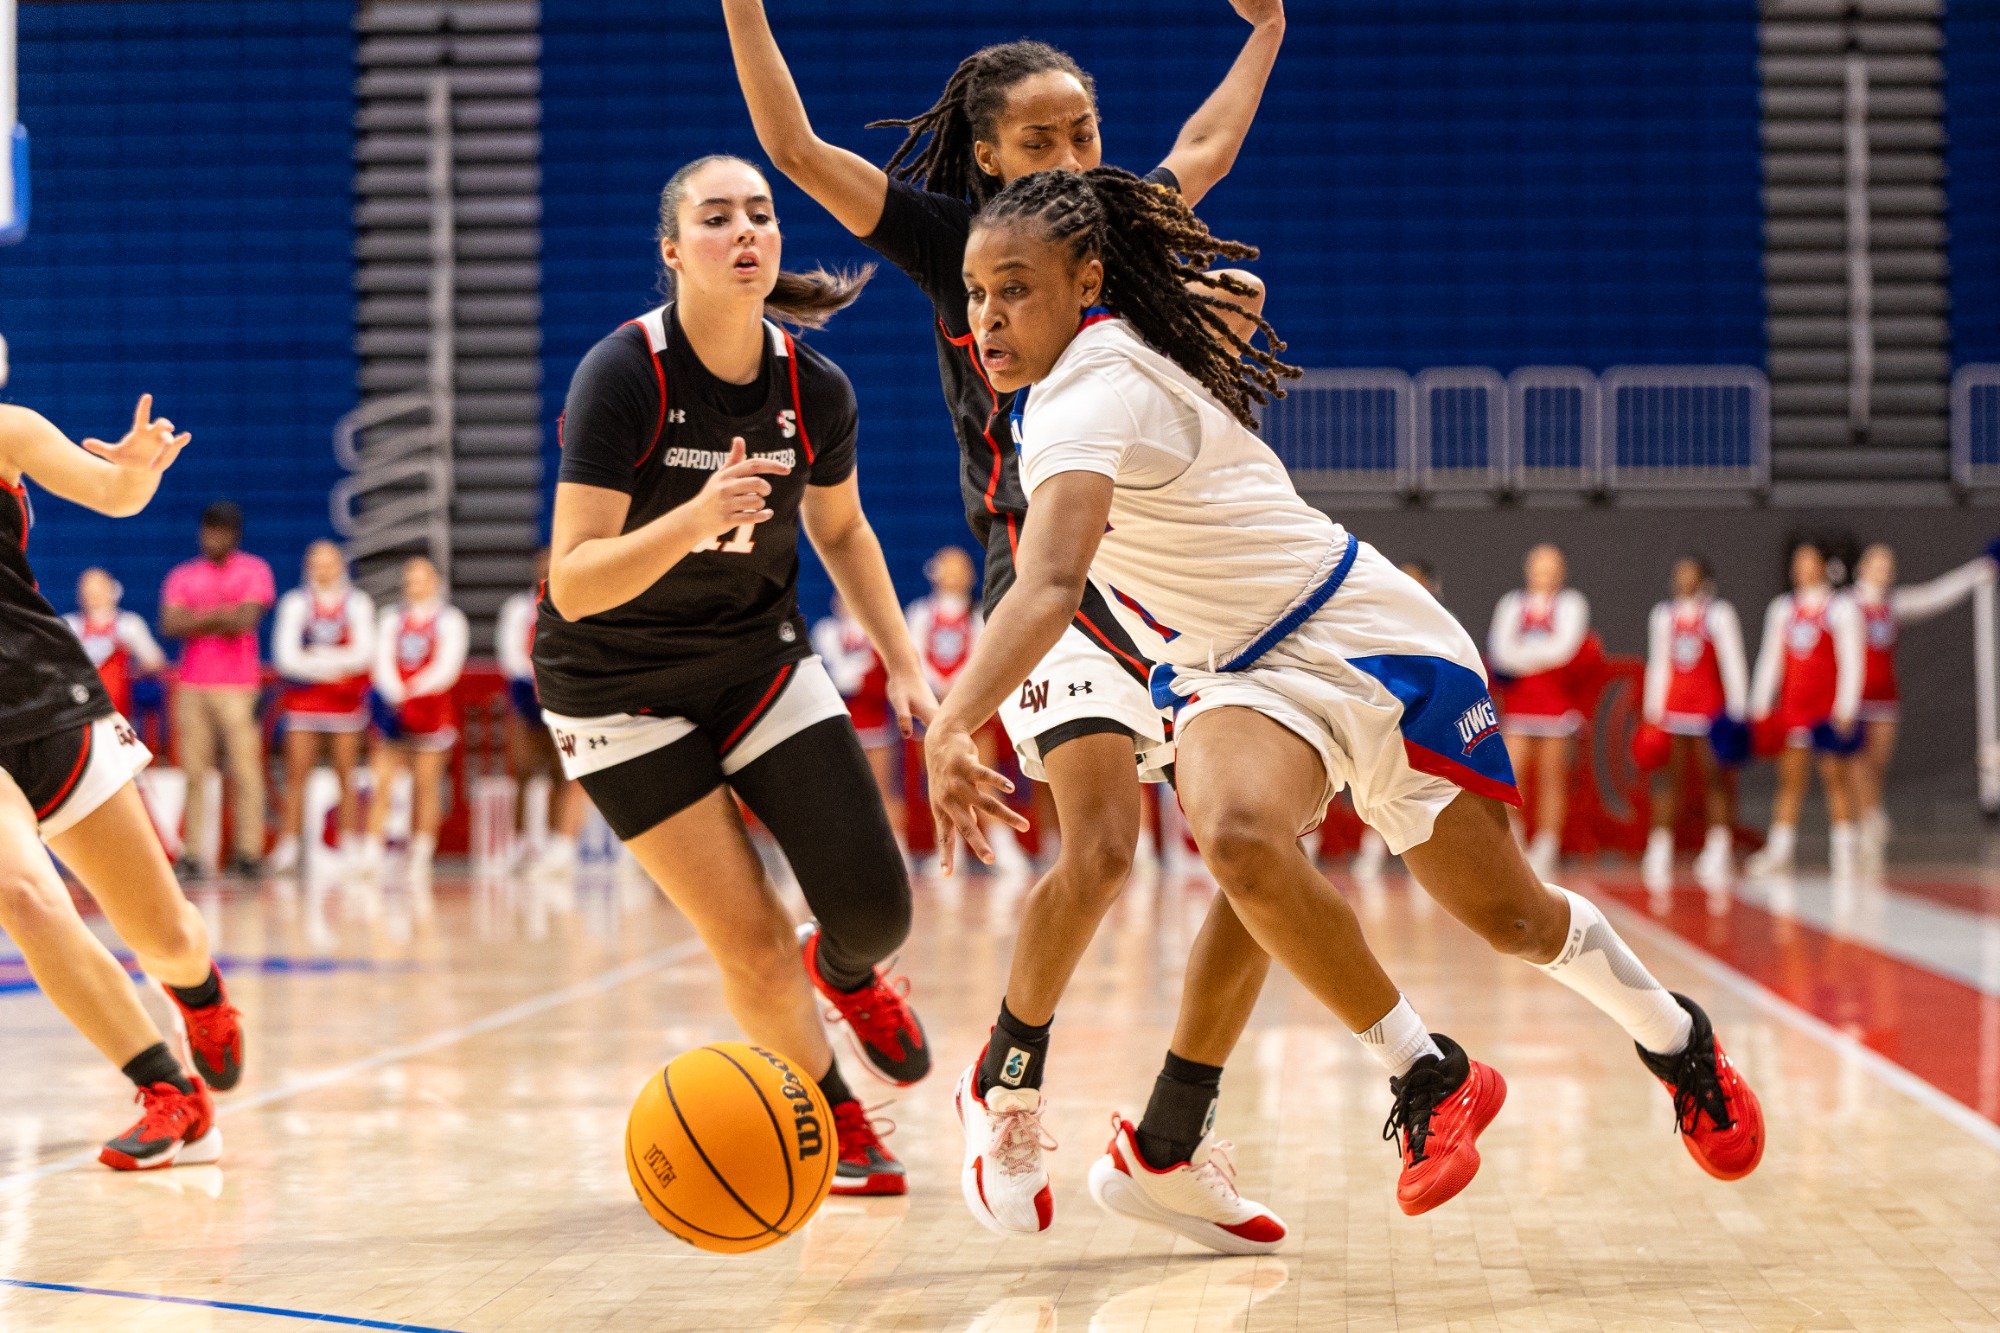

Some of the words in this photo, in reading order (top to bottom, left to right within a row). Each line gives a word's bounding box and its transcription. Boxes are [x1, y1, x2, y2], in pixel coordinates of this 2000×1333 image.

[1019, 678, 1049, 714] GW
[1457, 701, 1497, 743] UWG
[749, 1046, 823, 1161] Wilson
[643, 1143, 677, 1189] UWG
